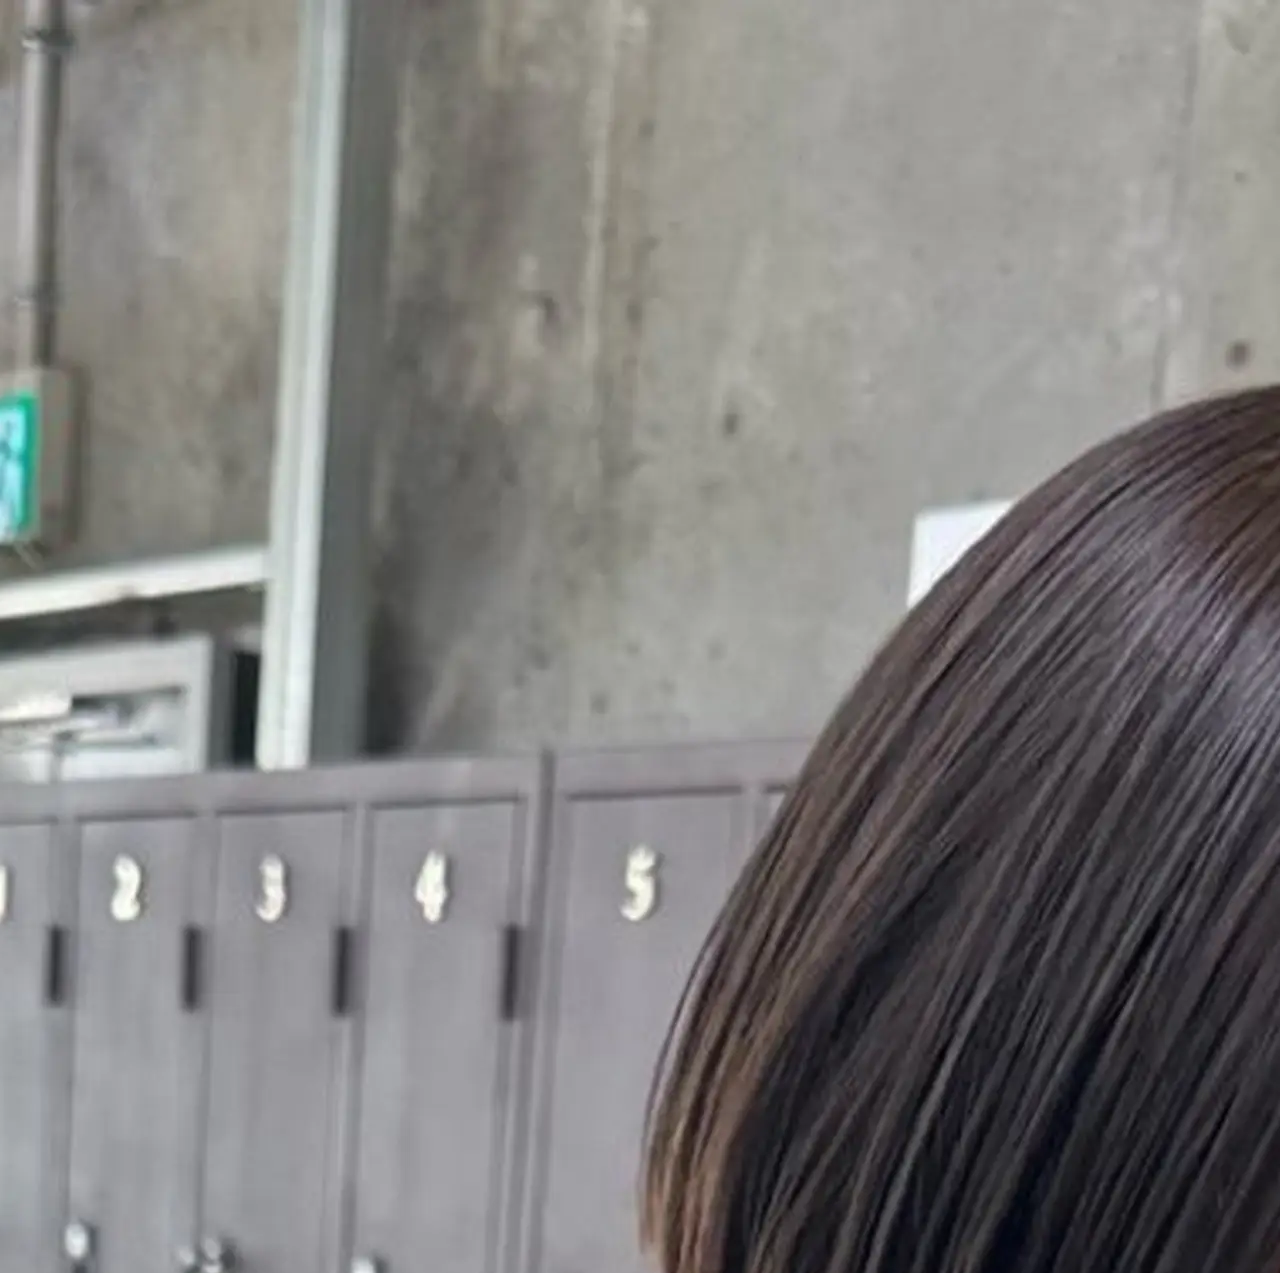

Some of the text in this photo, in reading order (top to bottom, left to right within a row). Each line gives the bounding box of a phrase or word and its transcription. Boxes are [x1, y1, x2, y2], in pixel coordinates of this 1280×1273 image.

[110, 854, 141, 921] 2
[255, 853, 285, 922] 3
[415, 849, 448, 922] 4
[620, 844, 656, 921] 5
